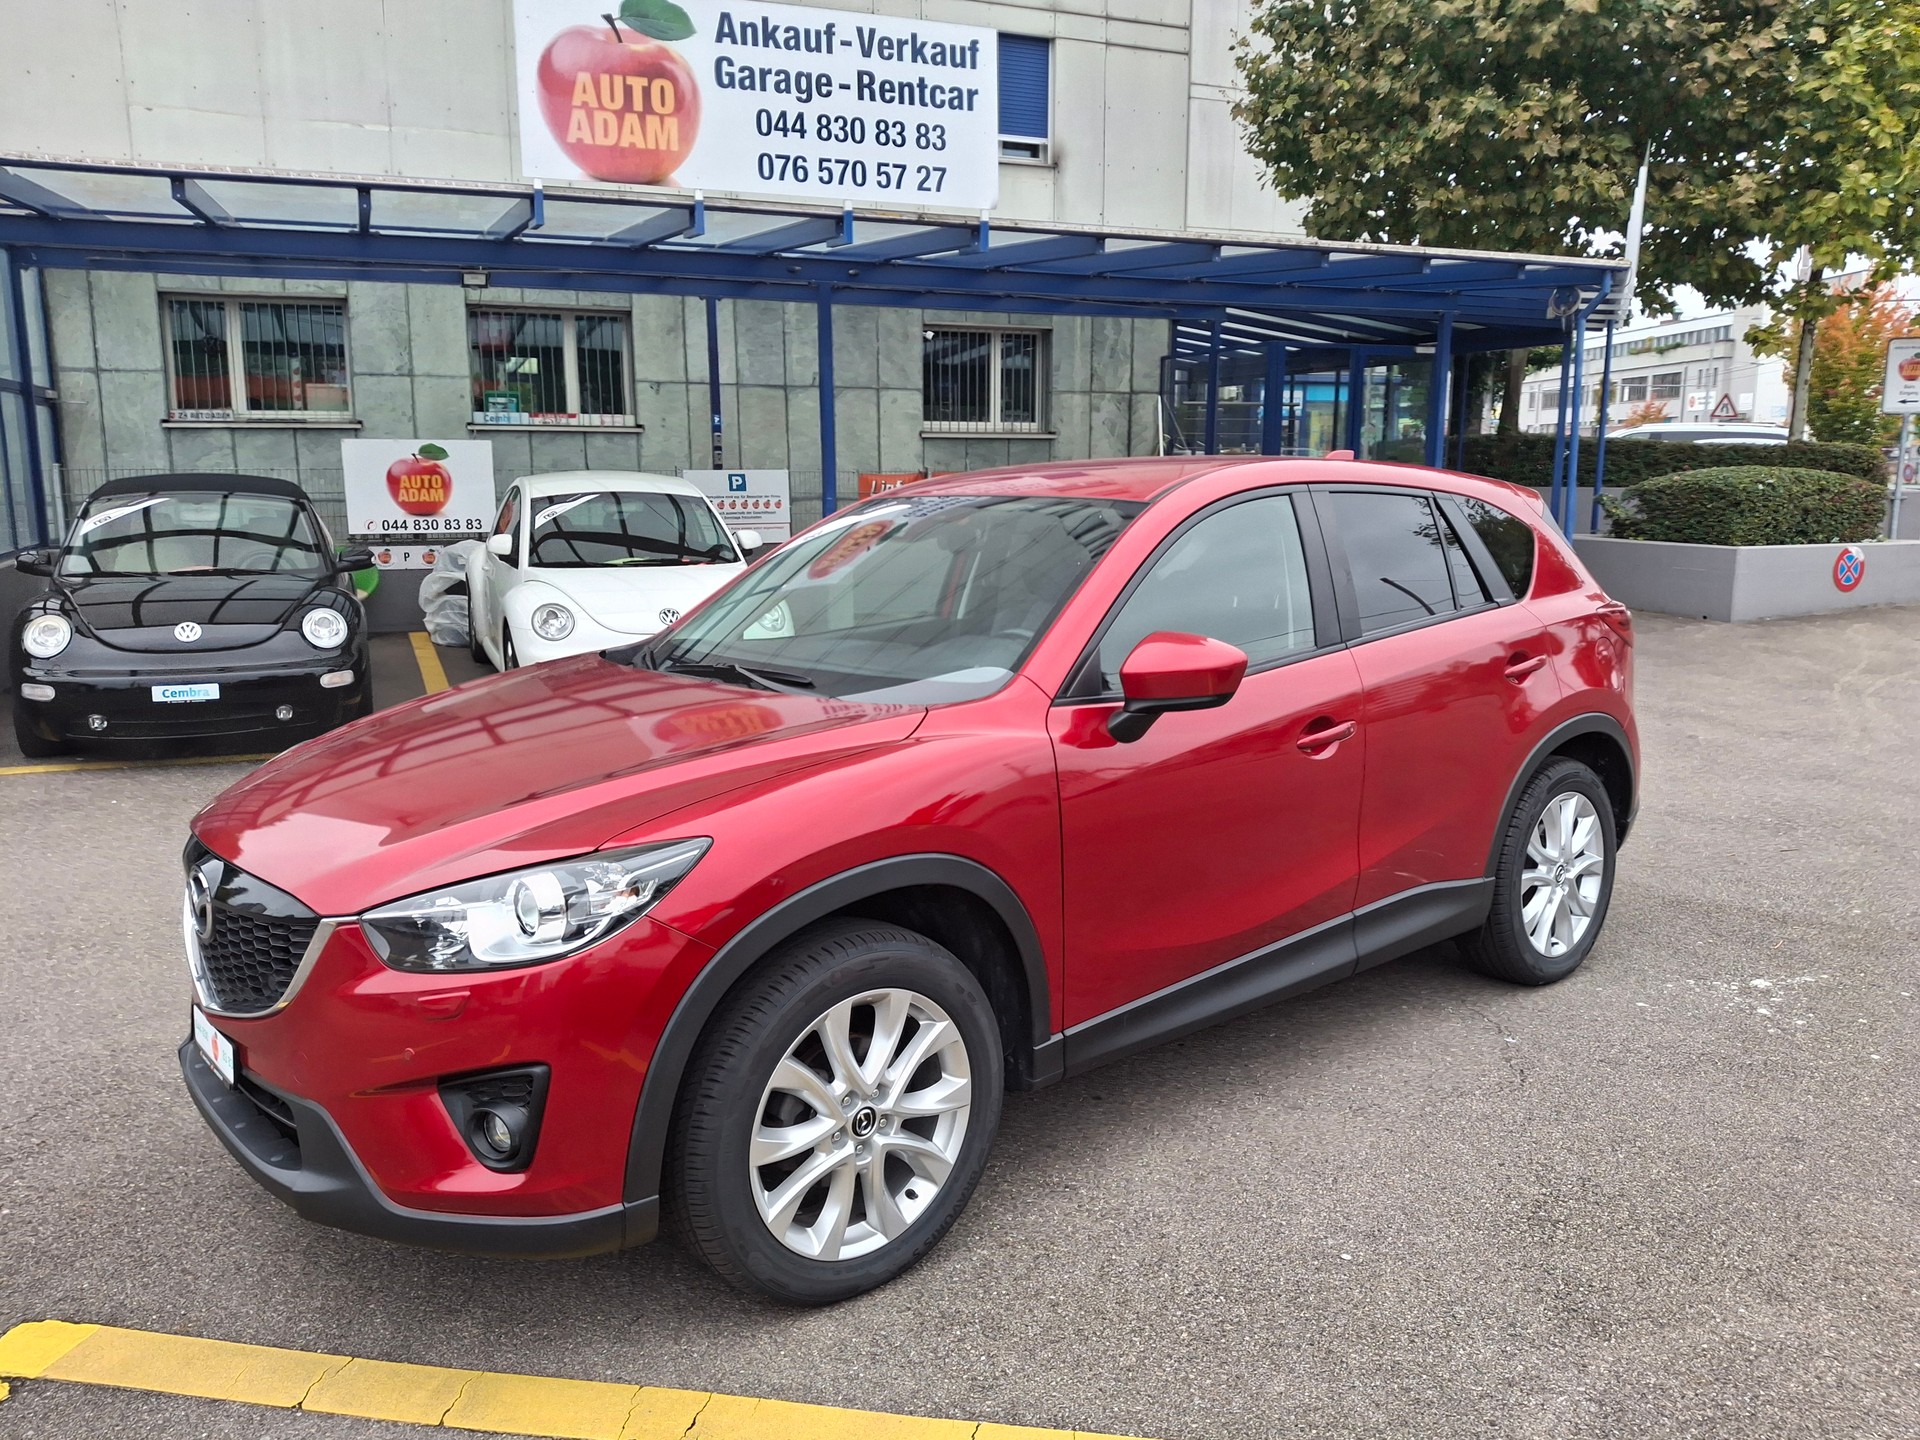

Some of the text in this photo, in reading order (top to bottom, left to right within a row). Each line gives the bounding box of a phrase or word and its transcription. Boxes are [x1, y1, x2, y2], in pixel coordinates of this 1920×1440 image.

[714, 11, 980, 71] Ankauf-Verkauf
[571, 72, 676, 115] AUTO
[713, 56, 979, 112] Garage-Rentcar
[566, 108, 679, 152] ADAM
[755, 108, 947, 152] 044 830 83 83
[757, 152, 948, 194] 076 570 57 27
[398, 488, 445, 503] ADAM
[400, 475, 442, 489] AUTO
[732, 476, 743, 490] P
[381, 518, 483, 532] 044 830 83 83
[403, 551, 411, 562] P
[162, 686, 210, 699] Cembra
